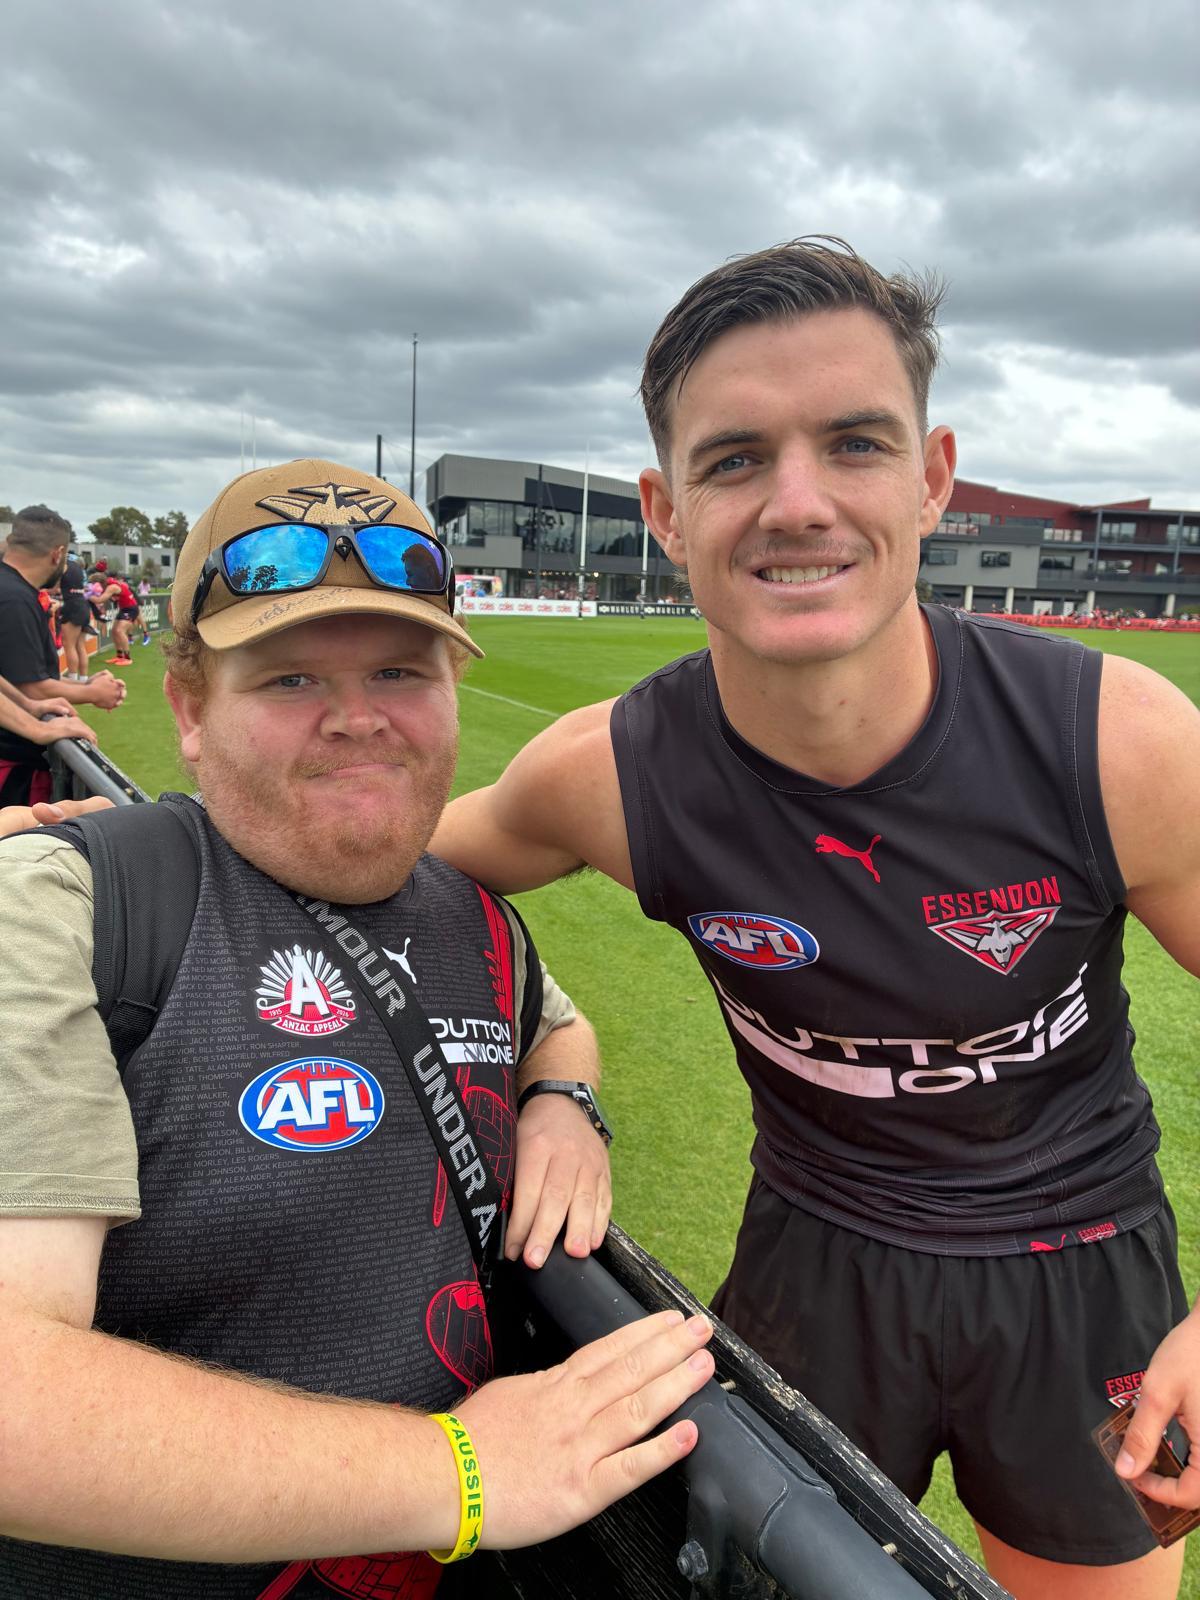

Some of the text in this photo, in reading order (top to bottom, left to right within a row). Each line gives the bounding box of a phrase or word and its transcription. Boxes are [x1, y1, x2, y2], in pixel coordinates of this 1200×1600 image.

[921, 876, 1062, 925] ESSENDON
[700, 920, 808, 961] AFL
[290, 955, 330, 1016] A
[269, 1008, 283, 1017] 1915
[281, 1019, 342, 1033] ANZAC APPEAL
[486, 1043, 513, 1065] ONE
[898, 992, 1088, 1094] ONE
[257, 1079, 375, 1130] AFL
[413, 1044, 487, 1200] UNDER
[1078, 1222, 1116, 1239] ESSENDON
[452, 1428, 482, 1519] AUSSIE
